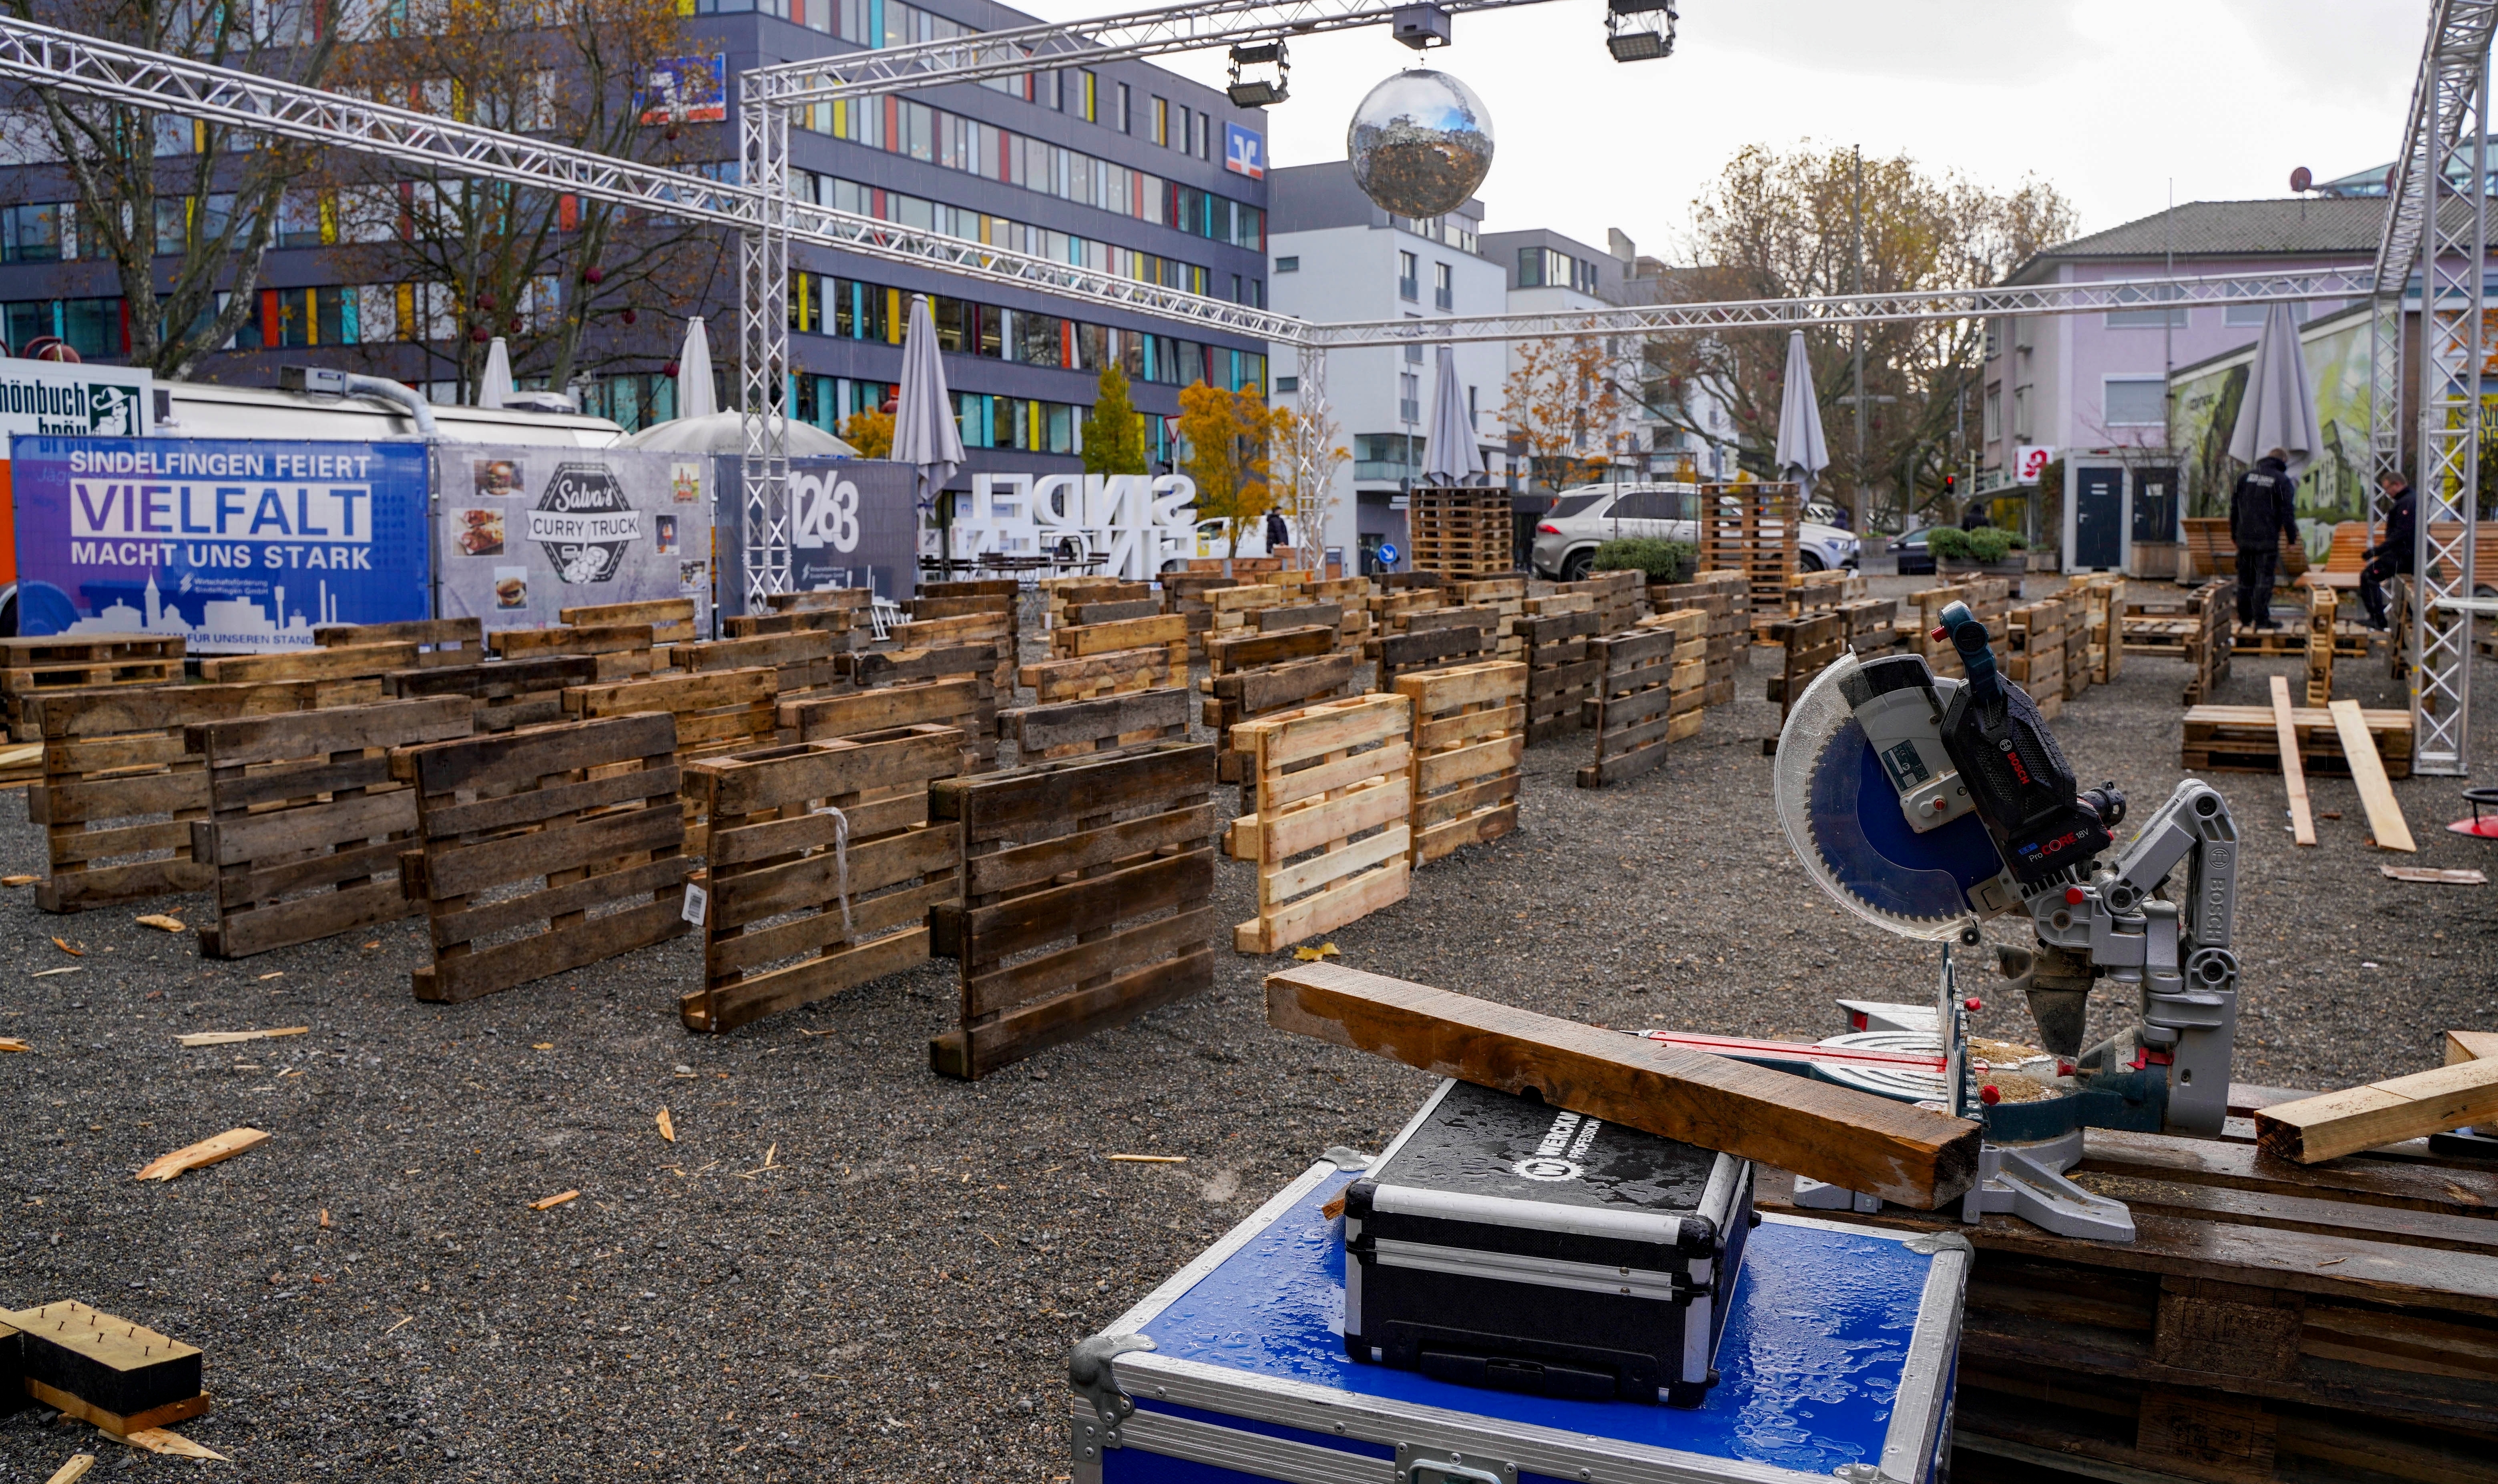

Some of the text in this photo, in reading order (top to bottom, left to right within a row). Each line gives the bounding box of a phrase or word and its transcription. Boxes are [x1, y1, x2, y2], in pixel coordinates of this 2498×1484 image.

[70, 450, 371, 478] SINDELFINGEN FEIERT
[75, 484, 367, 537] VIELFALT
[555, 479, 613, 512] Salva's
[533, 516, 638, 536] CURRY TRUCK
[788, 470, 859, 553] 1263
[71, 542, 371, 570] MACHT UNS STARK
[187, 632, 211, 643] FÜR
[214, 634, 269, 644] UNSEREN
[2006, 751, 2030, 785] BOSCH
[2076, 828, 2089, 839] 18V
[2206, 878, 2226, 941] BOSCH
